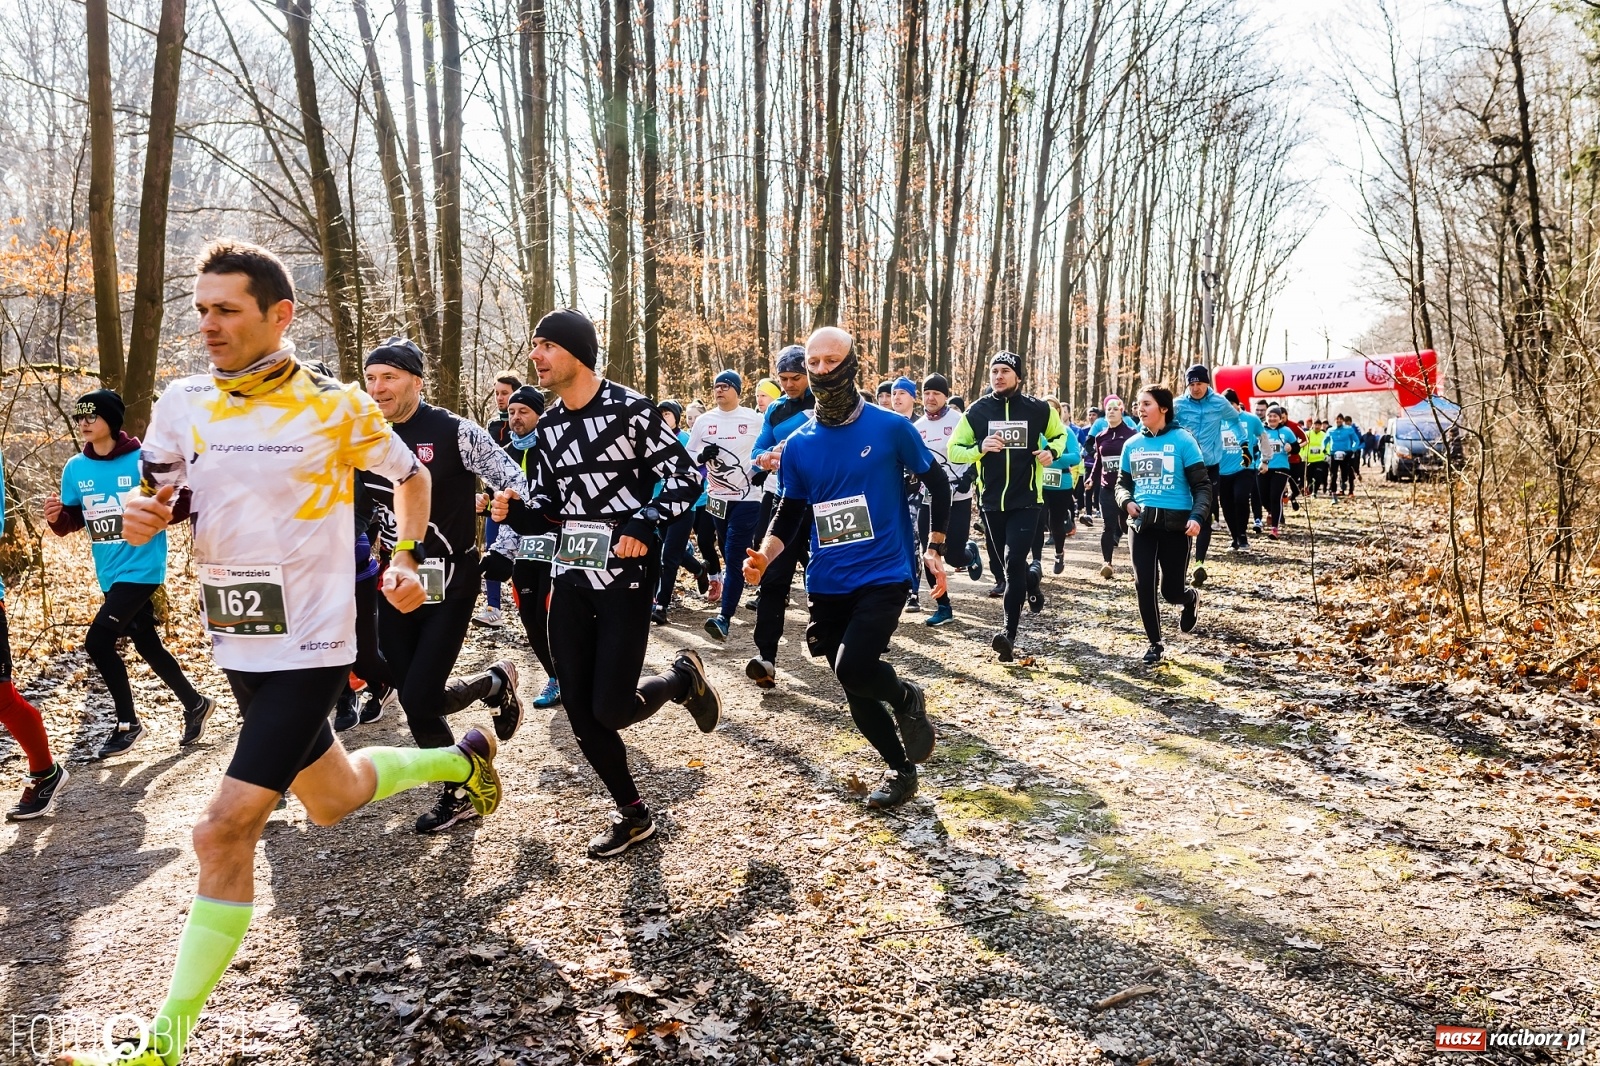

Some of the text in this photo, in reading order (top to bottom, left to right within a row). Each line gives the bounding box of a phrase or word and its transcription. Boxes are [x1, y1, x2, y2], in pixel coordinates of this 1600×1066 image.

[1290, 371, 1356, 381] TWARDZIELA
[1298, 381, 1350, 391] RACIBÓRZ
[258, 443, 304, 454] biegania
[1106, 461, 1117, 469] 104
[1135, 460, 1154, 472] 126
[1043, 473, 1055, 482] 101
[78, 479, 94, 489] DLO
[709, 497, 721, 511] 103
[831, 498, 859, 508] Twardziela
[93, 518, 116, 533] 007
[577, 522, 605, 530] Twardziela
[825, 512, 857, 533] 152
[522, 539, 545, 552] 132
[567, 536, 598, 555] 047
[227, 569, 271, 577] Twardziela
[217, 589, 264, 617] 162
[300, 640, 346, 651] #ibteam
